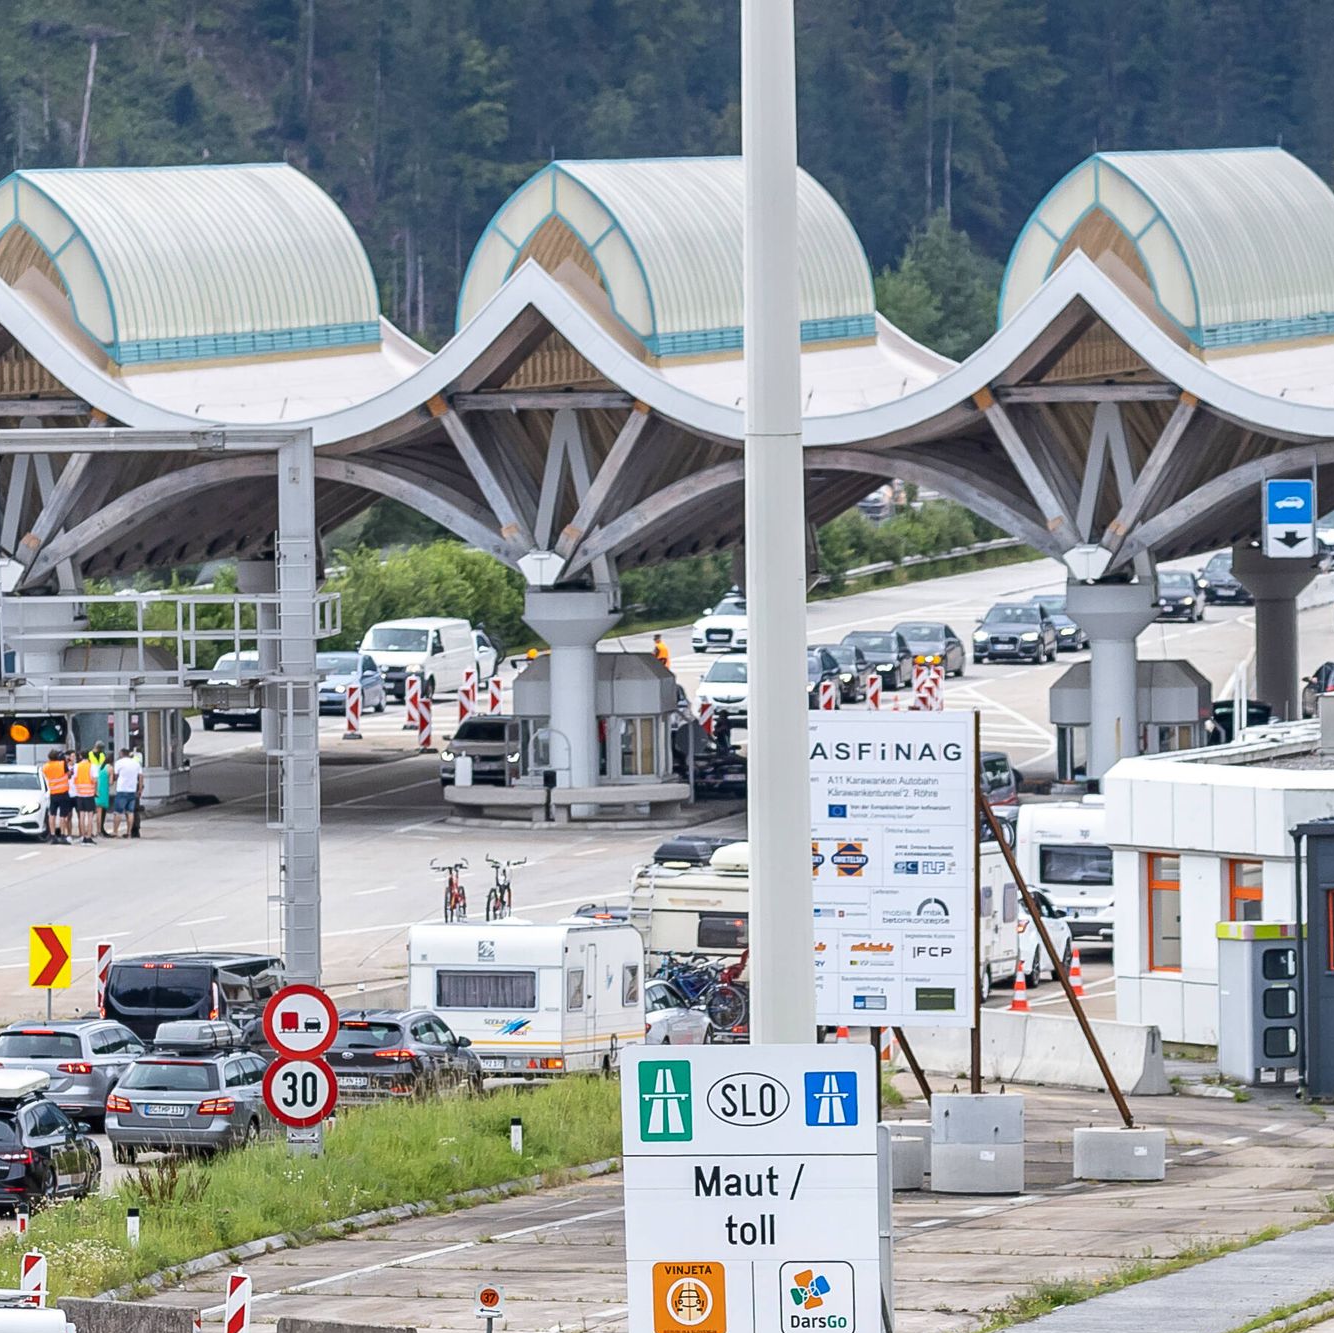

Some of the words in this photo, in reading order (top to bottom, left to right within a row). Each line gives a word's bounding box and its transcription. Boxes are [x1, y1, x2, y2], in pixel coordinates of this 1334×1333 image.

[845, 776, 898, 785] Karawanken
[899, 776, 939, 785] Autobahn
[913, 788, 939, 798] Röhre
[281, 1071, 318, 1108] 30
[720, 1083, 777, 1117] SLO
[693, 1165, 780, 1197] Maut
[789, 1163, 805, 1200] /
[724, 1213, 776, 1245] toll
[664, 1265, 713, 1275] VINJETA
[482, 1292, 496, 1304] 37
[790, 1315, 847, 1329] DarsGo
